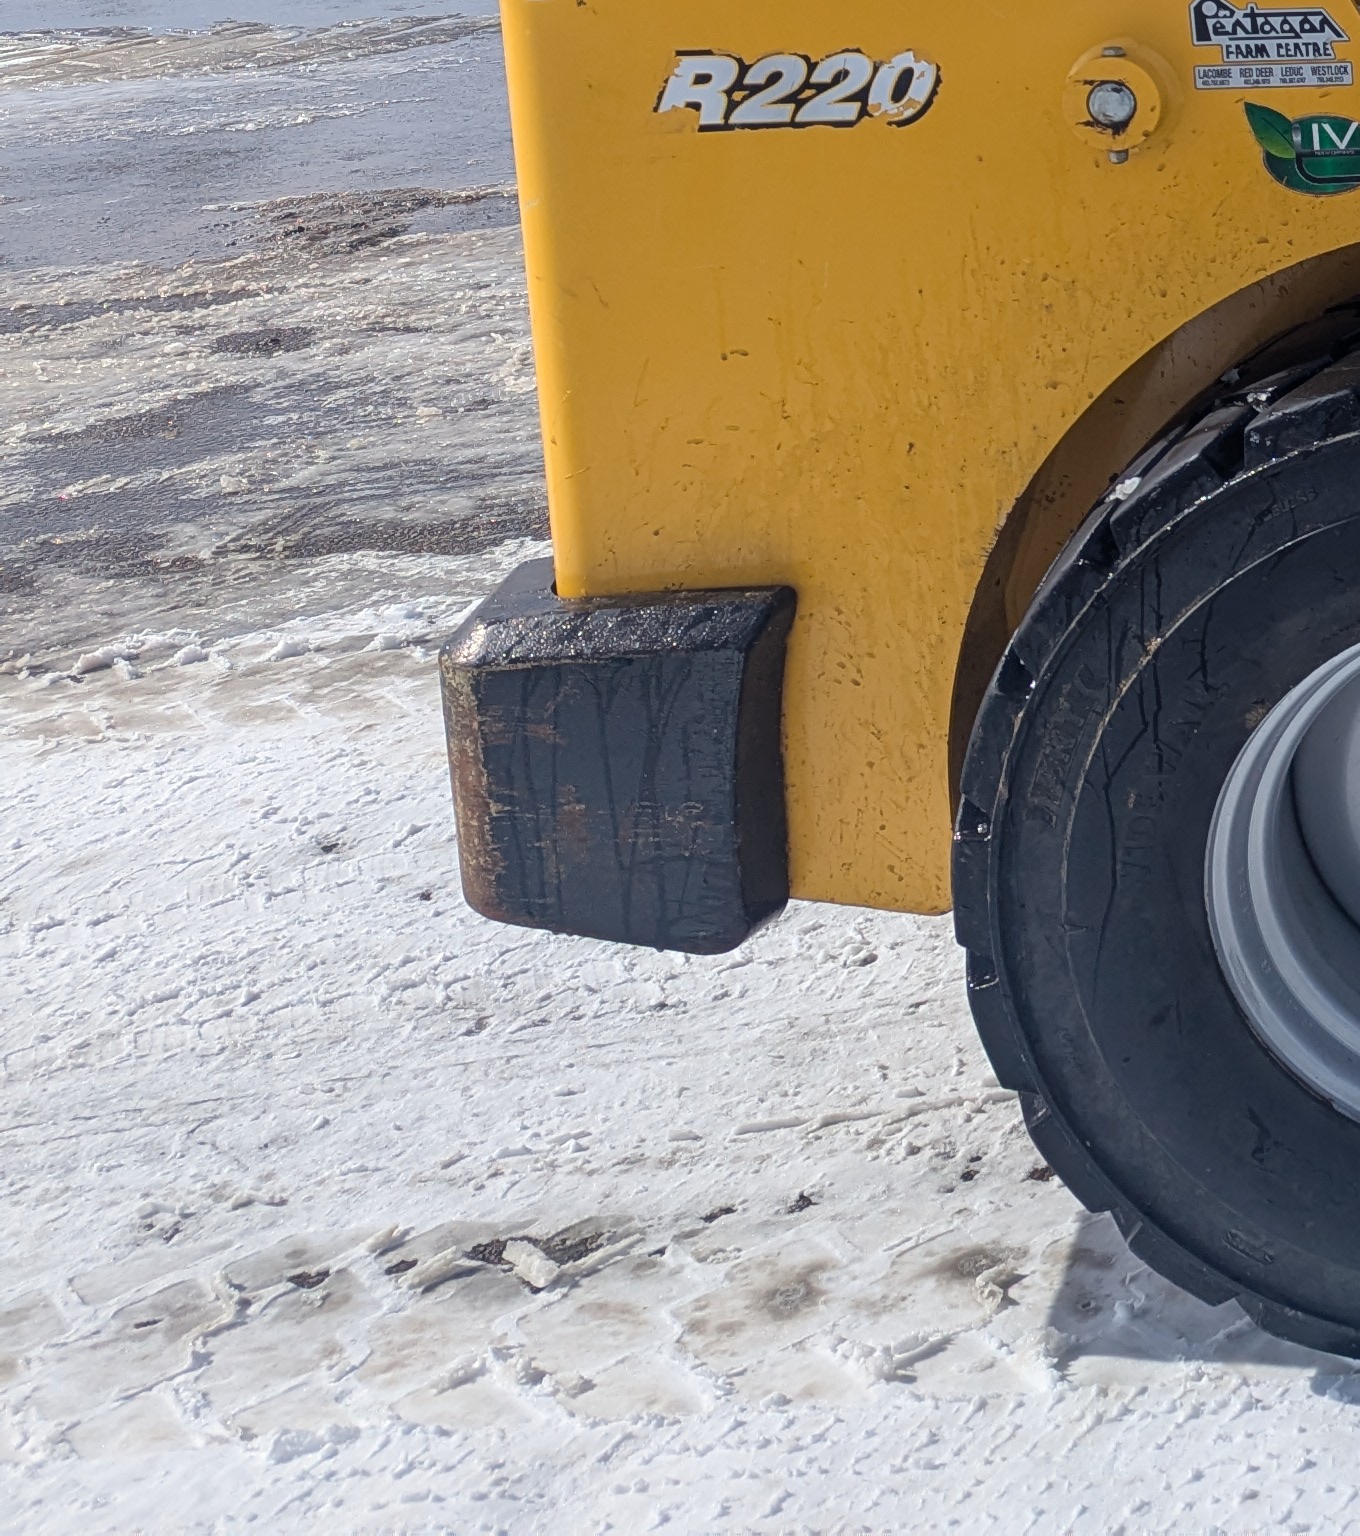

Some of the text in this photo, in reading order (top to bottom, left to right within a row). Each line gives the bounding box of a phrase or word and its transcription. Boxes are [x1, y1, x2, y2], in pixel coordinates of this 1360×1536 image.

[1226, 41, 1332, 59] FARM CENTRE
[1198, 64, 1349, 79] LACOMBE RED DEER LEDUC WESTLOCK
[652, 48, 941, 131] R220
[1311, 121, 1359, 151] IV
